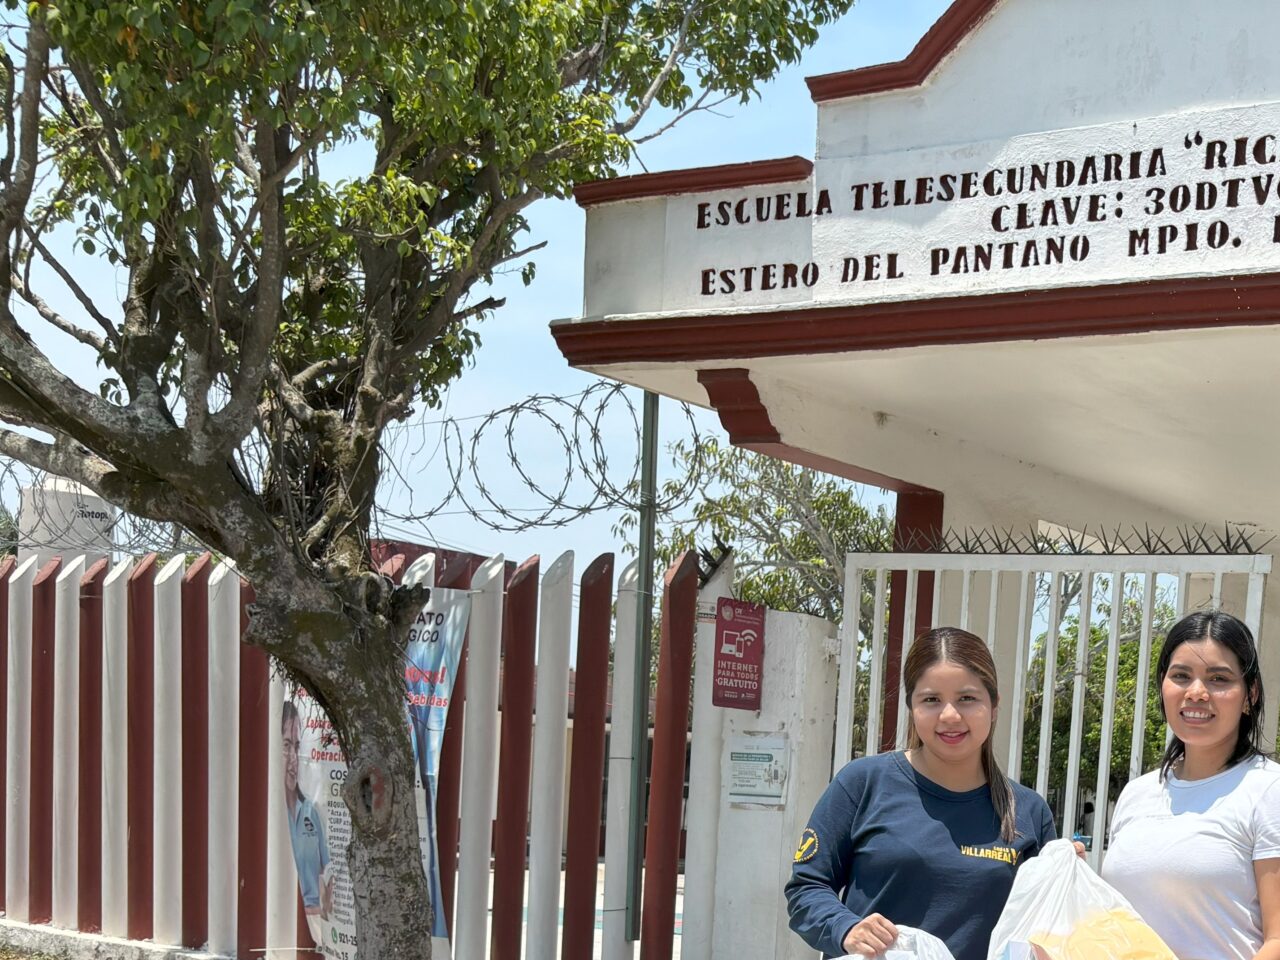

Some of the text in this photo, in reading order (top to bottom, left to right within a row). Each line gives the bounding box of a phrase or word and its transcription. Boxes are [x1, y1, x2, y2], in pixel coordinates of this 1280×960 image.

[697, 190, 832, 230] ESCUELA
[851, 148, 1167, 212] TELESECUNDARIA
[992, 192, 1124, 233] CLAVE:
[701, 263, 821, 296] ESTERO
[841, 253, 904, 283] DEL
[930, 234, 1090, 276] PANTANO
[1128, 219, 1242, 257] MPIO.
[717, 660, 759, 673] INTERNET
[717, 669, 759, 681] PARA TODOS
[716, 677, 758, 690] GRATUITO
[960, 845, 1012, 864] VILLARREAL
